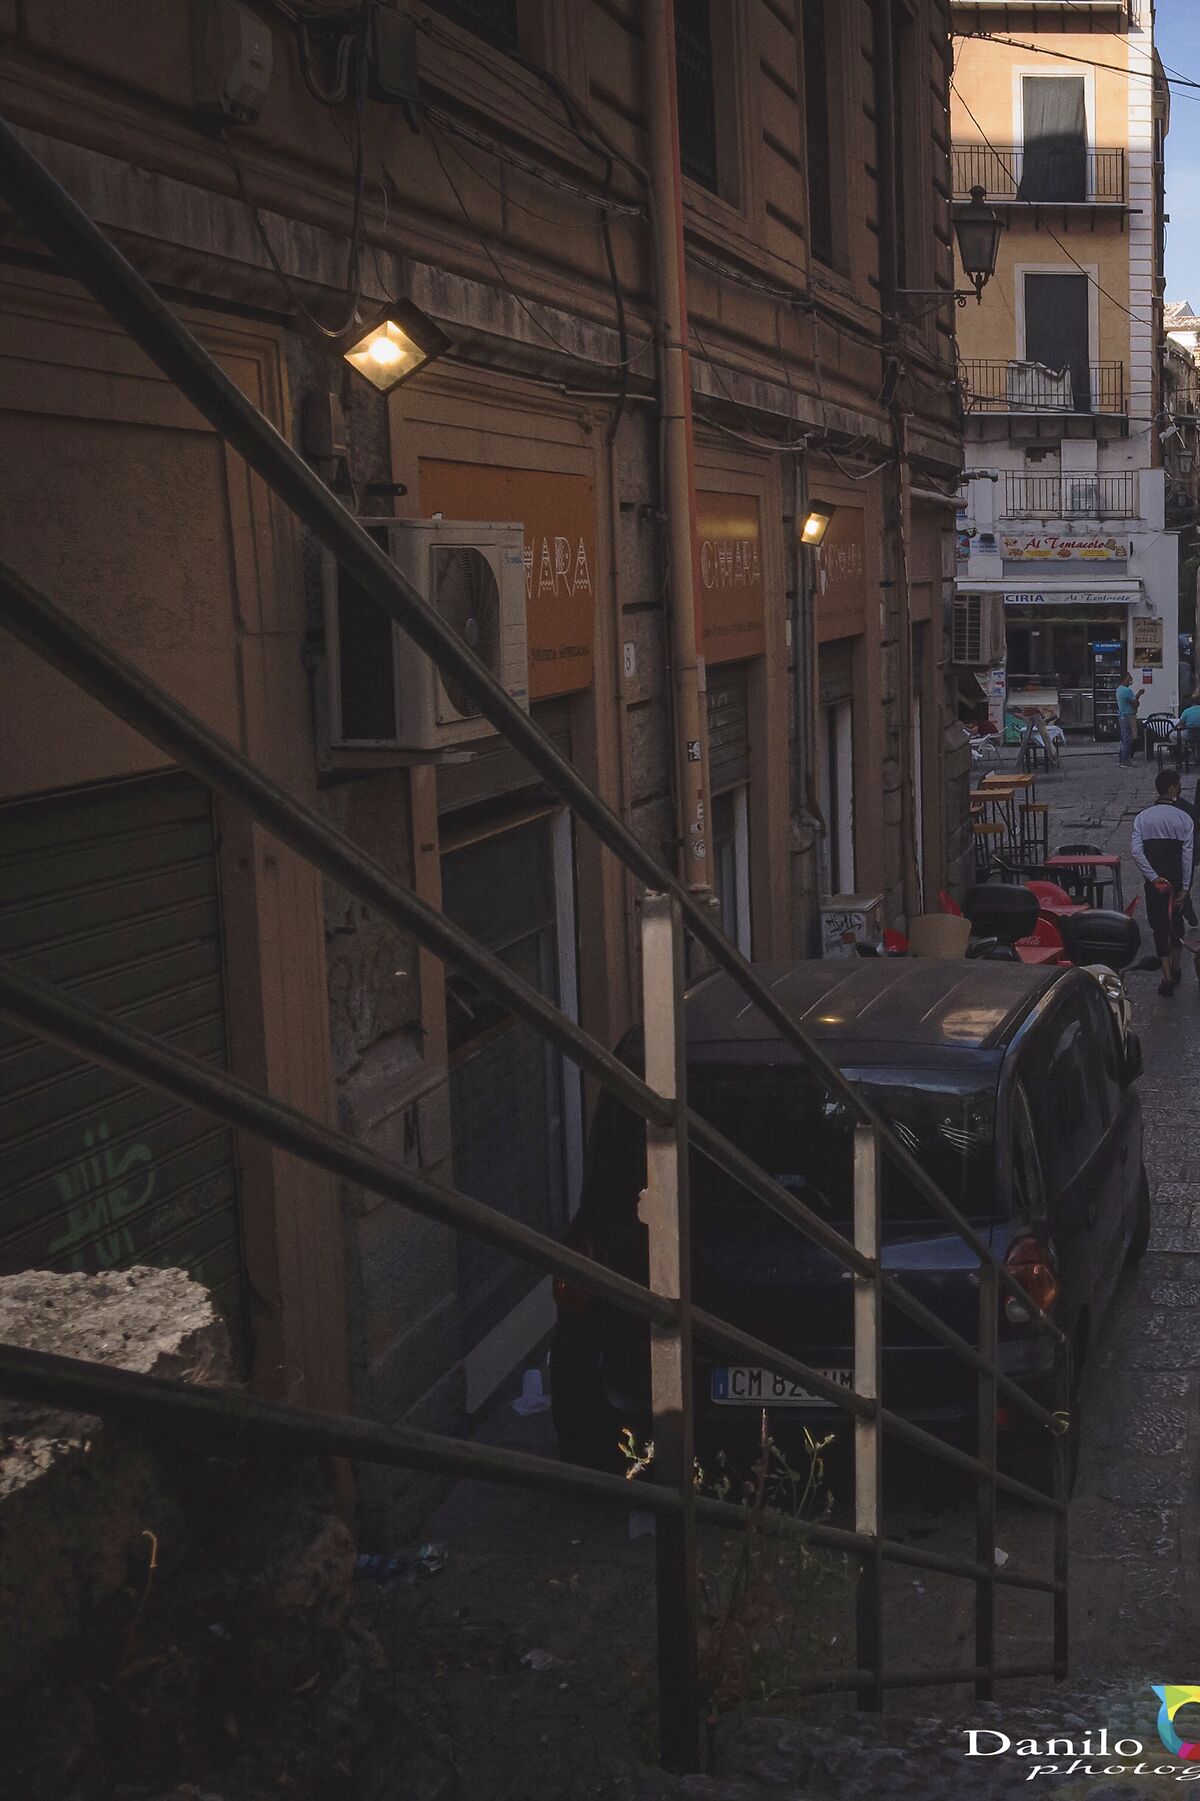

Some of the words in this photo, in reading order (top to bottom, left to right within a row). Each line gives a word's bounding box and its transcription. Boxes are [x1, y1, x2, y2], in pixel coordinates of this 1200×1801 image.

[1023, 537, 1041, 550] Al
[1044, 537, 1105, 550] Tentacolo
[1003, 594, 1045, 603] CIRIA
[732, 1369, 762, 1397] CM
